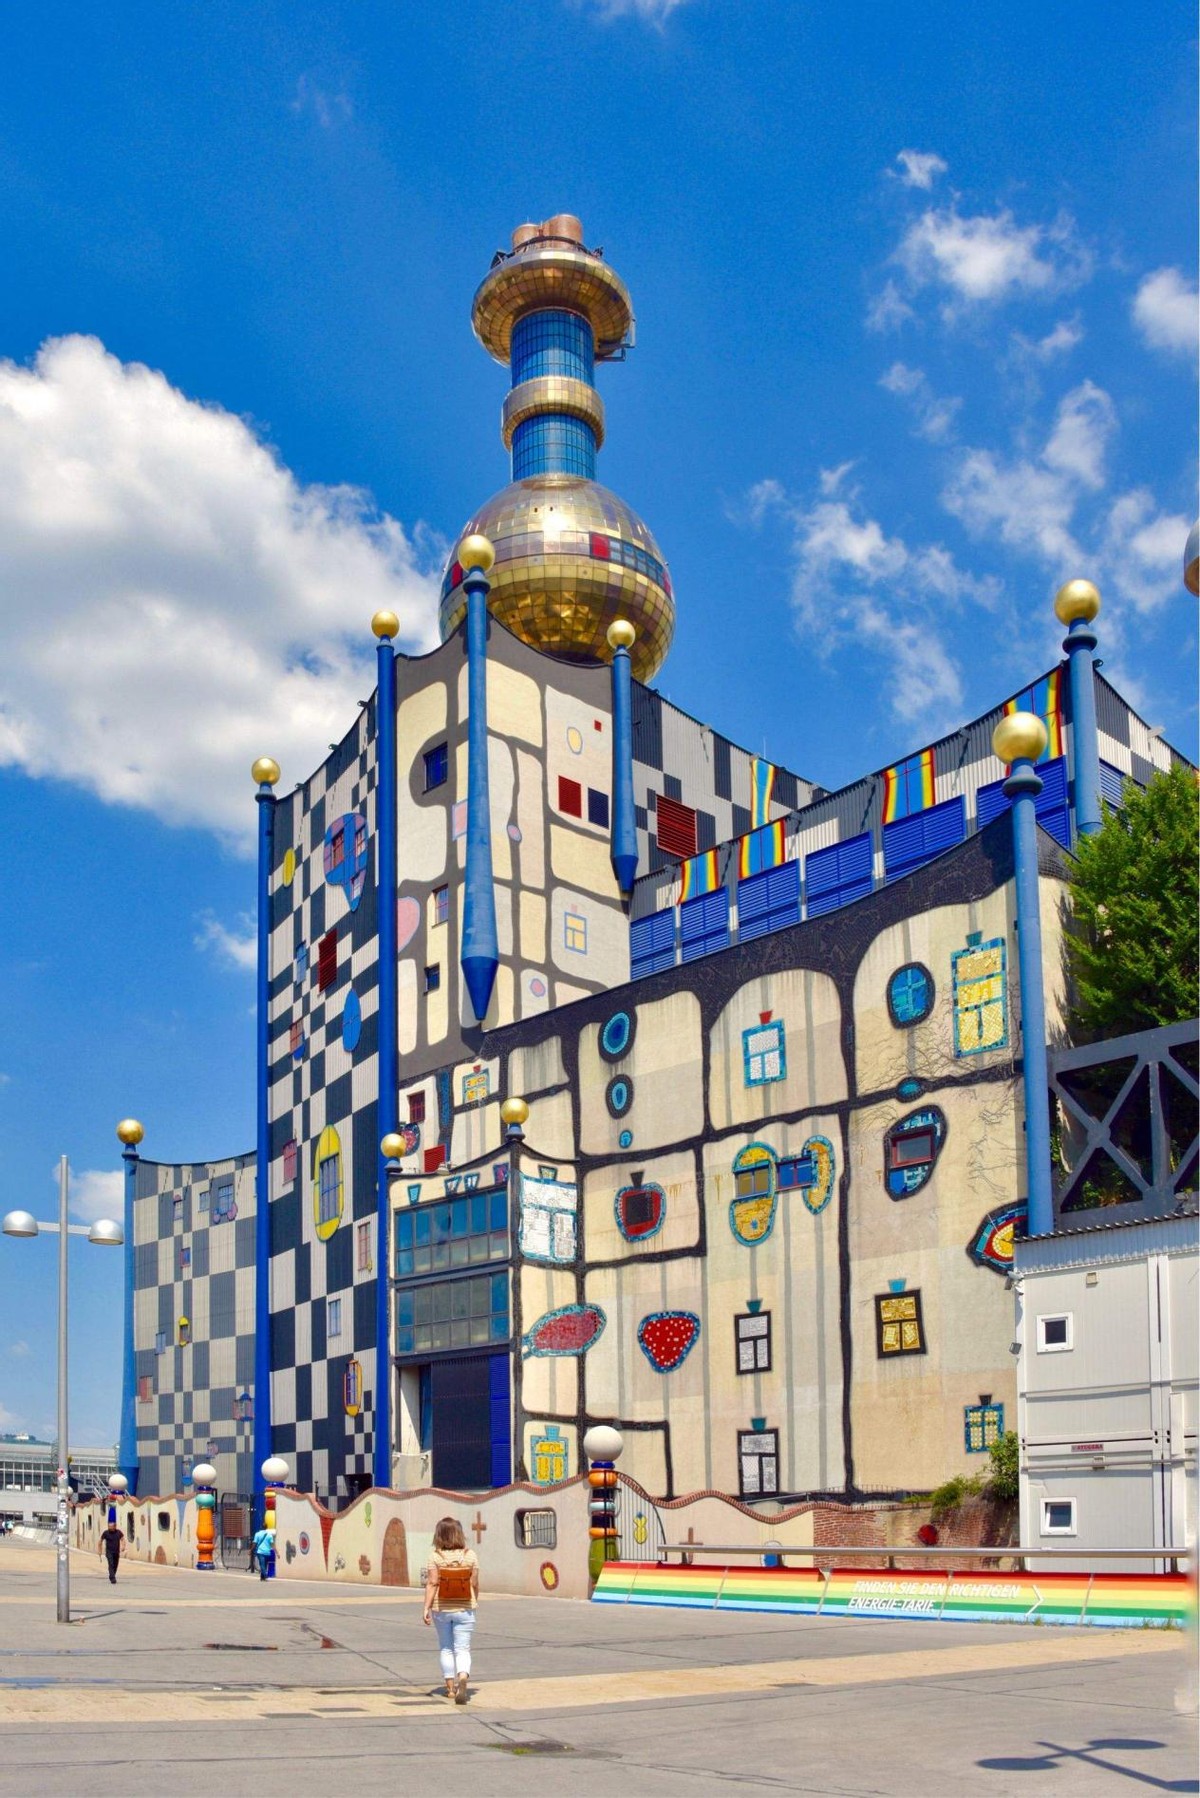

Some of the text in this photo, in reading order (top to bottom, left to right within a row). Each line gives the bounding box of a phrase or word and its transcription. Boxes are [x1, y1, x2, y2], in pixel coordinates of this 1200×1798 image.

[853, 1581, 1020, 1598] FINDEN SIE DEN RICHTIGEN
